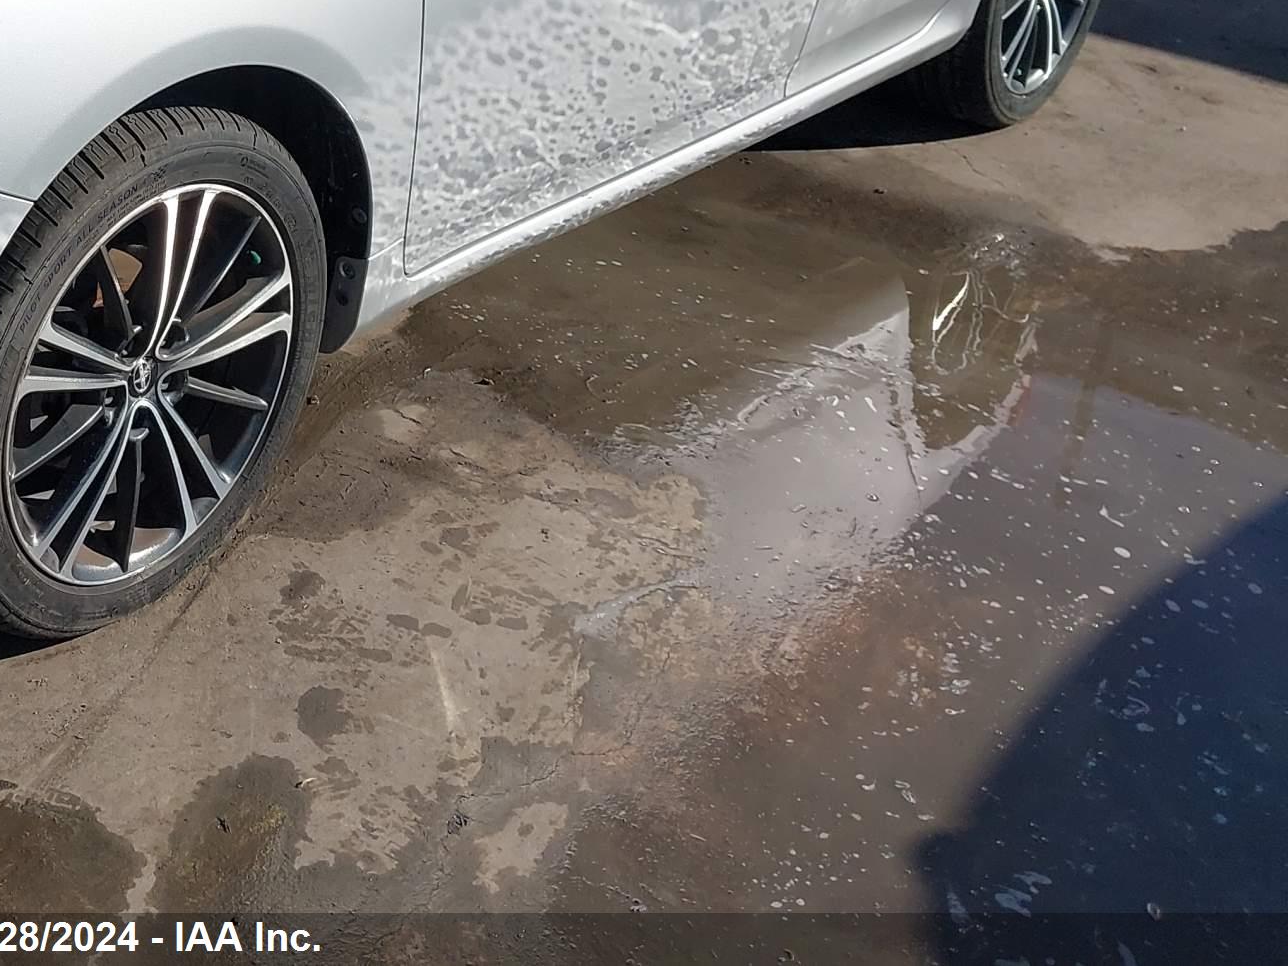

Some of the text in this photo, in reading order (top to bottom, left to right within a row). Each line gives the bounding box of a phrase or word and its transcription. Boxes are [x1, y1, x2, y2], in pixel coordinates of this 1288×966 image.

[19, 292, 42, 334] PILOT
[43, 247, 73, 288] SPORT
[97, 183, 139, 220] SEASON
